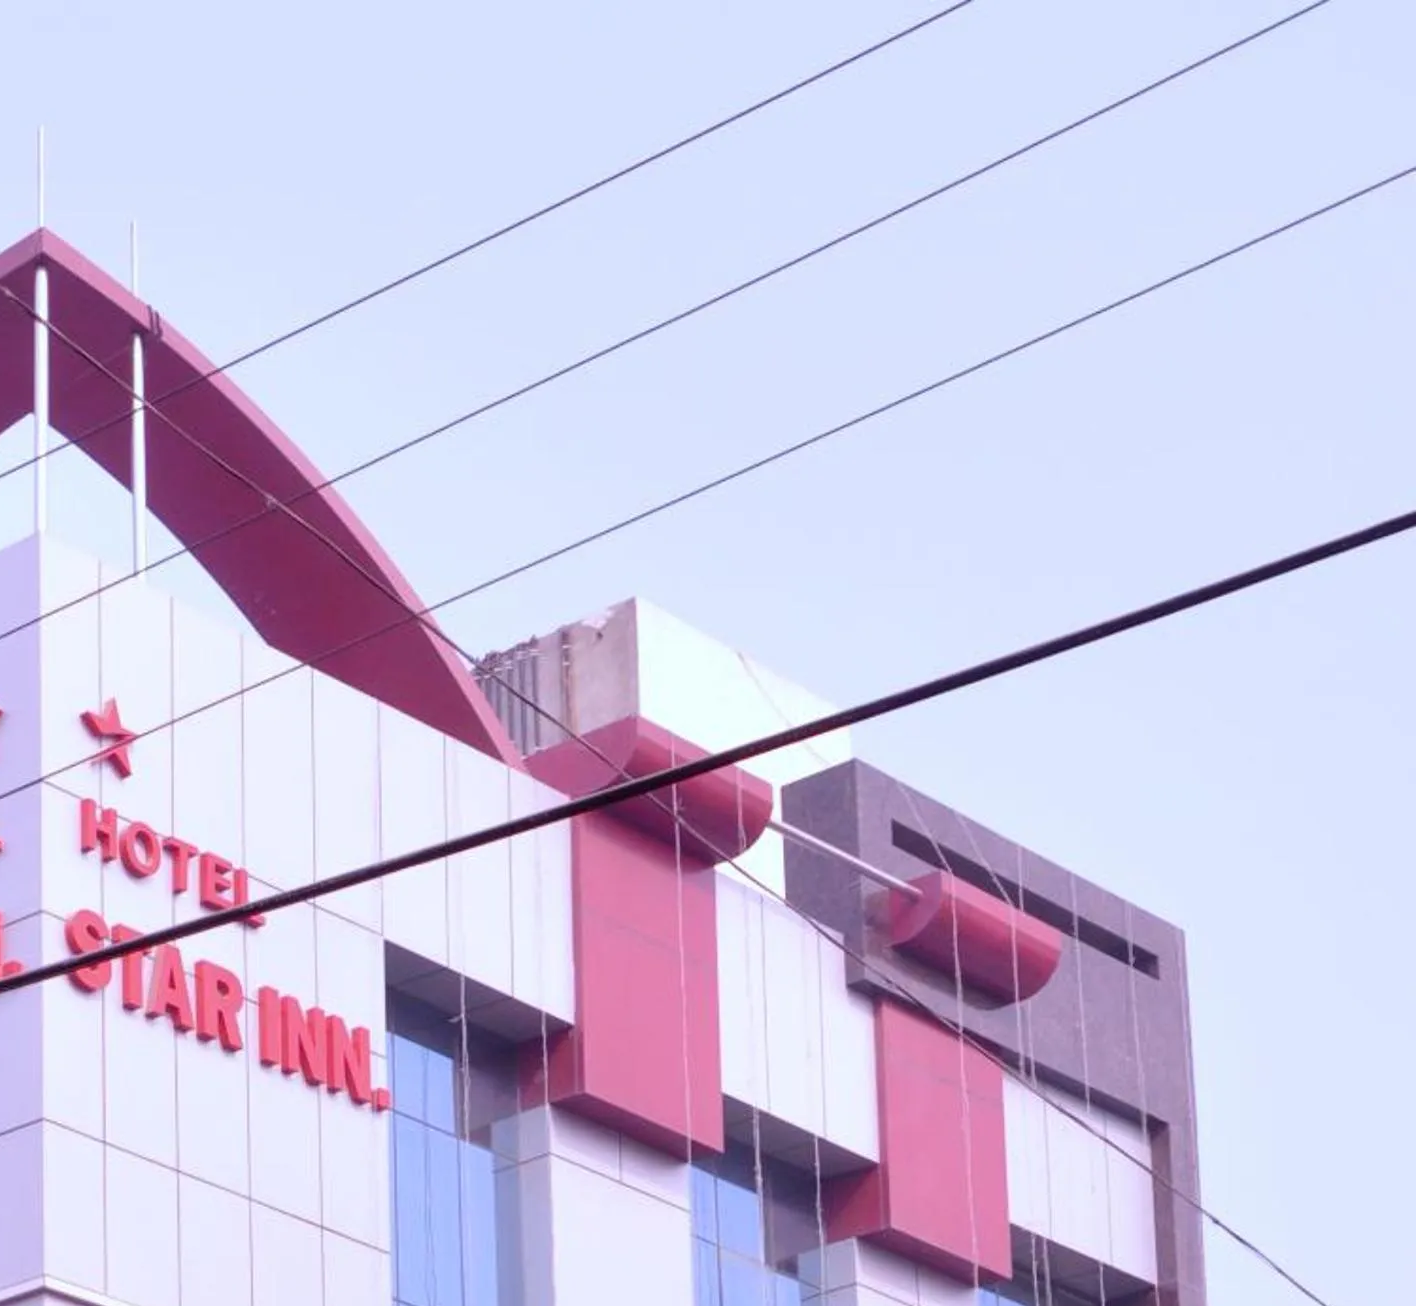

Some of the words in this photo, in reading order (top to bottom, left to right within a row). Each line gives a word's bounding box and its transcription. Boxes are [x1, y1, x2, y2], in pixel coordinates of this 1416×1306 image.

[80, 798, 267, 929] HOTEL
[64, 909, 244, 1054] STAR
[257, 985, 392, 1113] INN.
